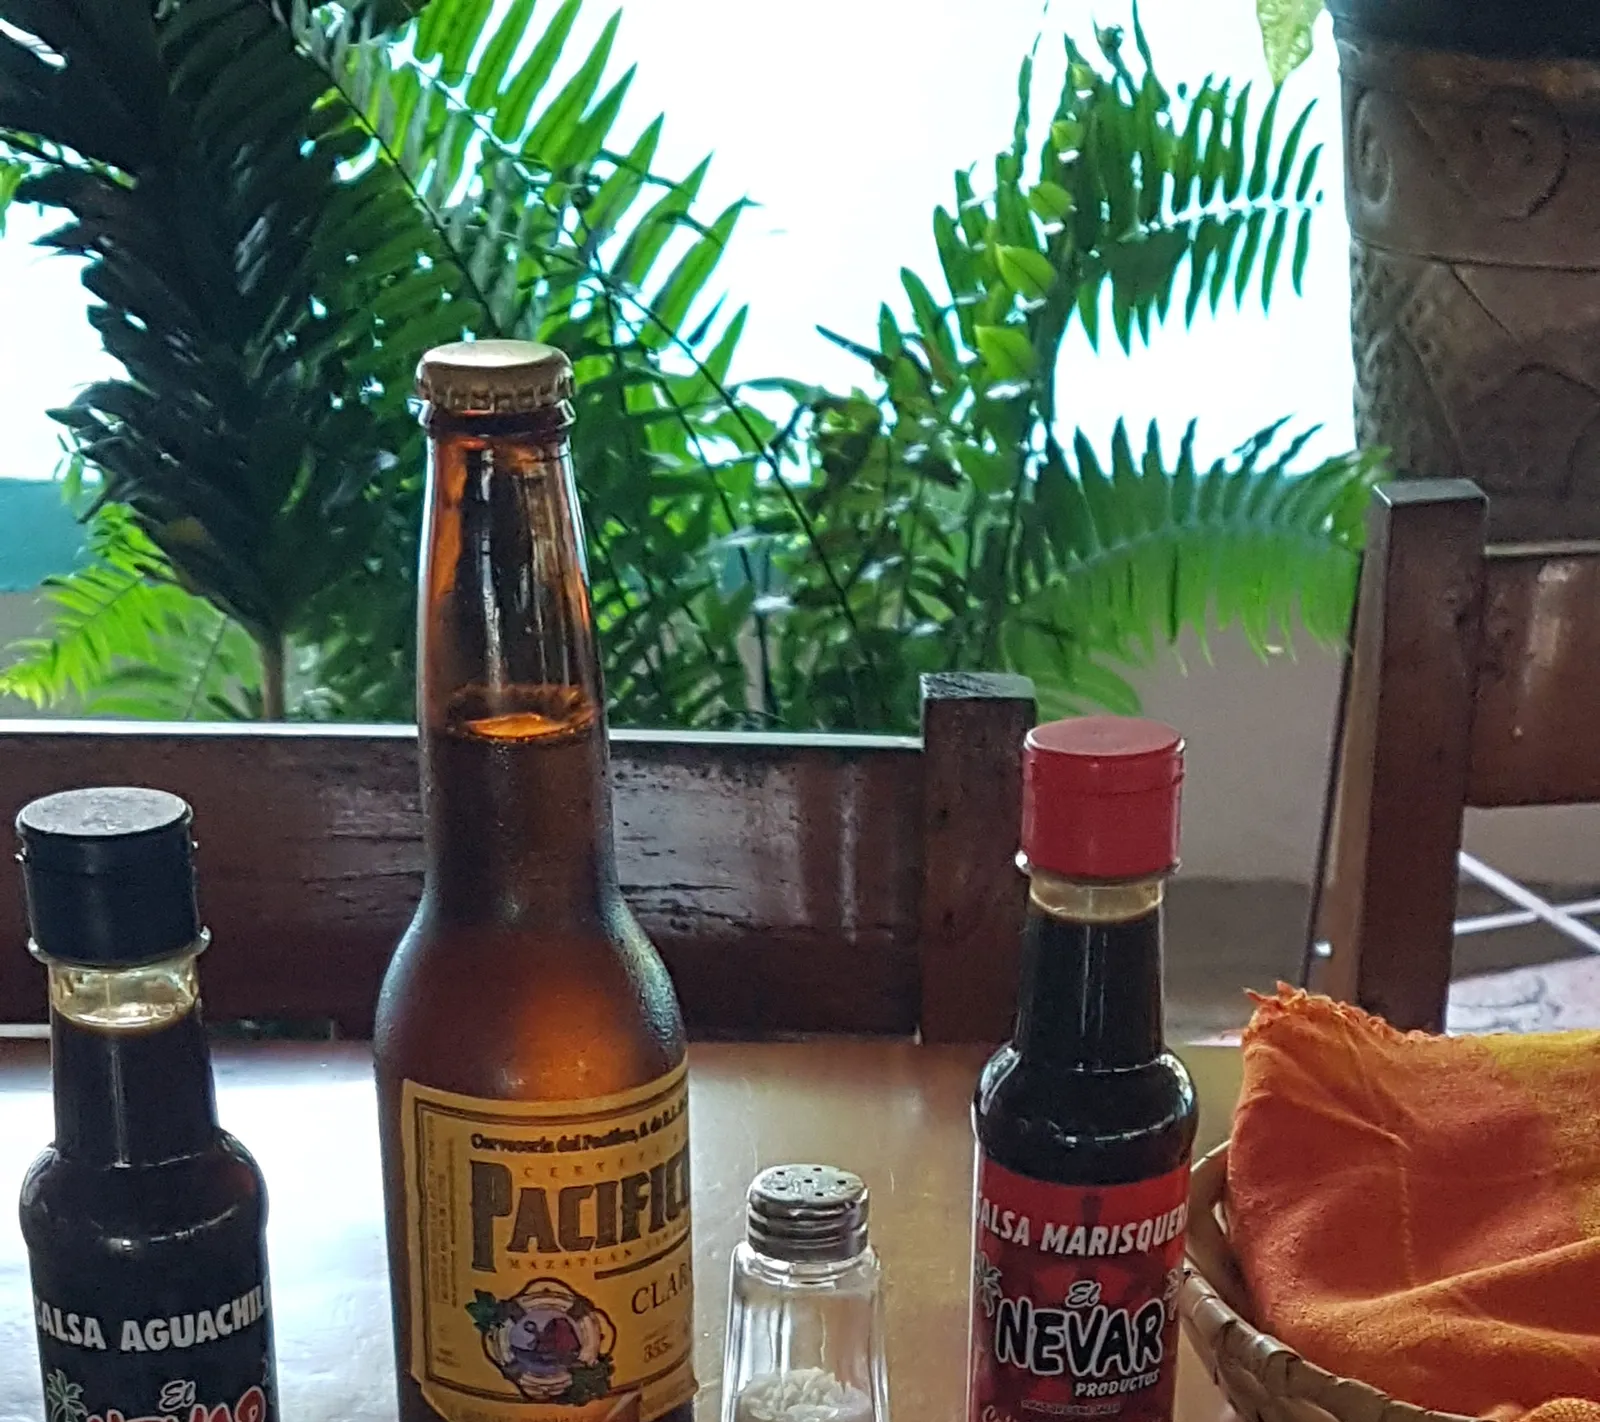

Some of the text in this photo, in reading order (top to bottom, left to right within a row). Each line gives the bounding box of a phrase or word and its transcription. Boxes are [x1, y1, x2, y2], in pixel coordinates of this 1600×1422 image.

[631, 1258, 692, 1315] CLAR
[1065, 1280, 1101, 1308] El
[120, 1285, 265, 1351] AGUACHIL
[996, 1296, 1164, 1377] NEVAR
[159, 1380, 196, 1412] El
